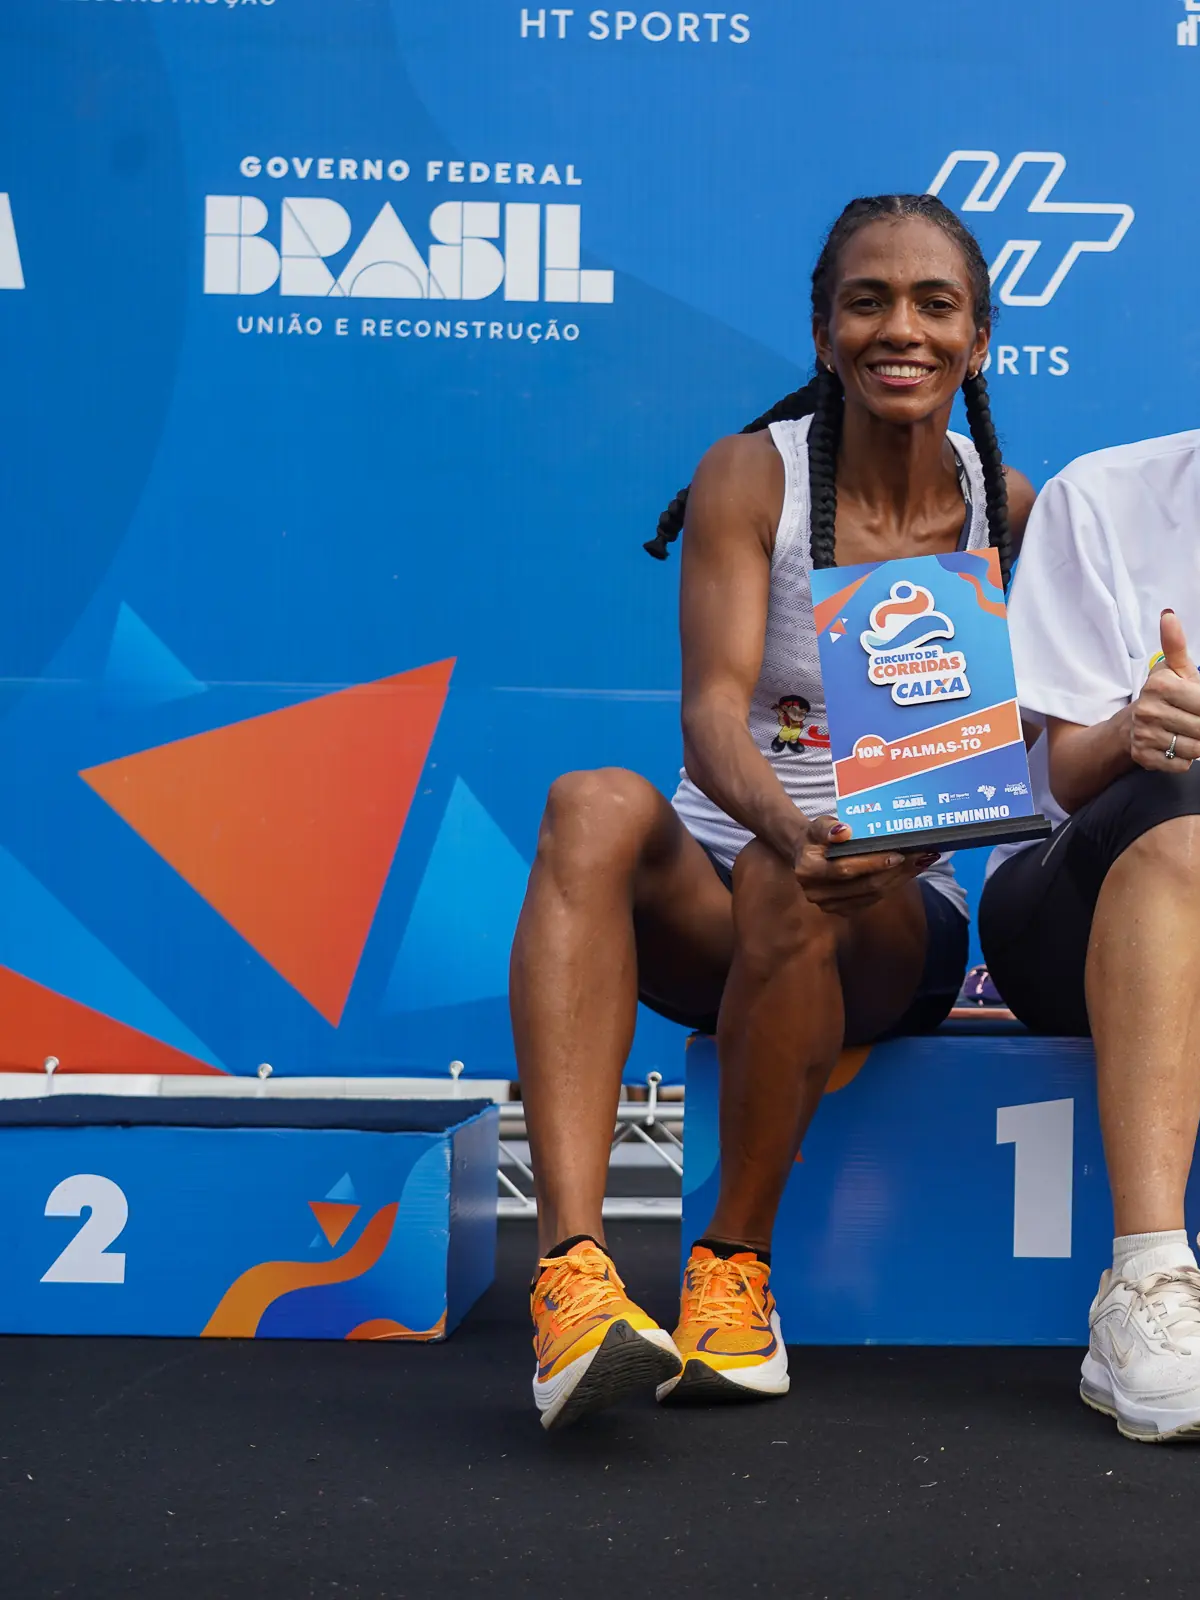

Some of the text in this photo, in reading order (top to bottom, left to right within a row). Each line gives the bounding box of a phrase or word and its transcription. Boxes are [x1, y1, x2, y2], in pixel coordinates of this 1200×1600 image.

[520, 9, 751, 44] HT SPORTS
[240, 156, 584, 187] GOVERNO FEDERAL
[203, 194, 615, 304] BRASIL
[237, 312, 581, 345] UNIÃO E RECONSTRUÇÃO
[873, 656, 961, 678] CORRIDAS
[874, 650, 938, 665] CIRCUITO DE
[896, 676, 965, 699] CAIXA
[961, 724, 991, 738] 2024
[857, 738, 982, 761] 10K PALMAS-TO
[846, 802, 882, 815] CAIXA
[886, 816, 933, 833] LUGAR
[938, 805, 1010, 825] FEMININO
[996, 1098, 1074, 1258] 1
[40, 1174, 128, 1284] 2
